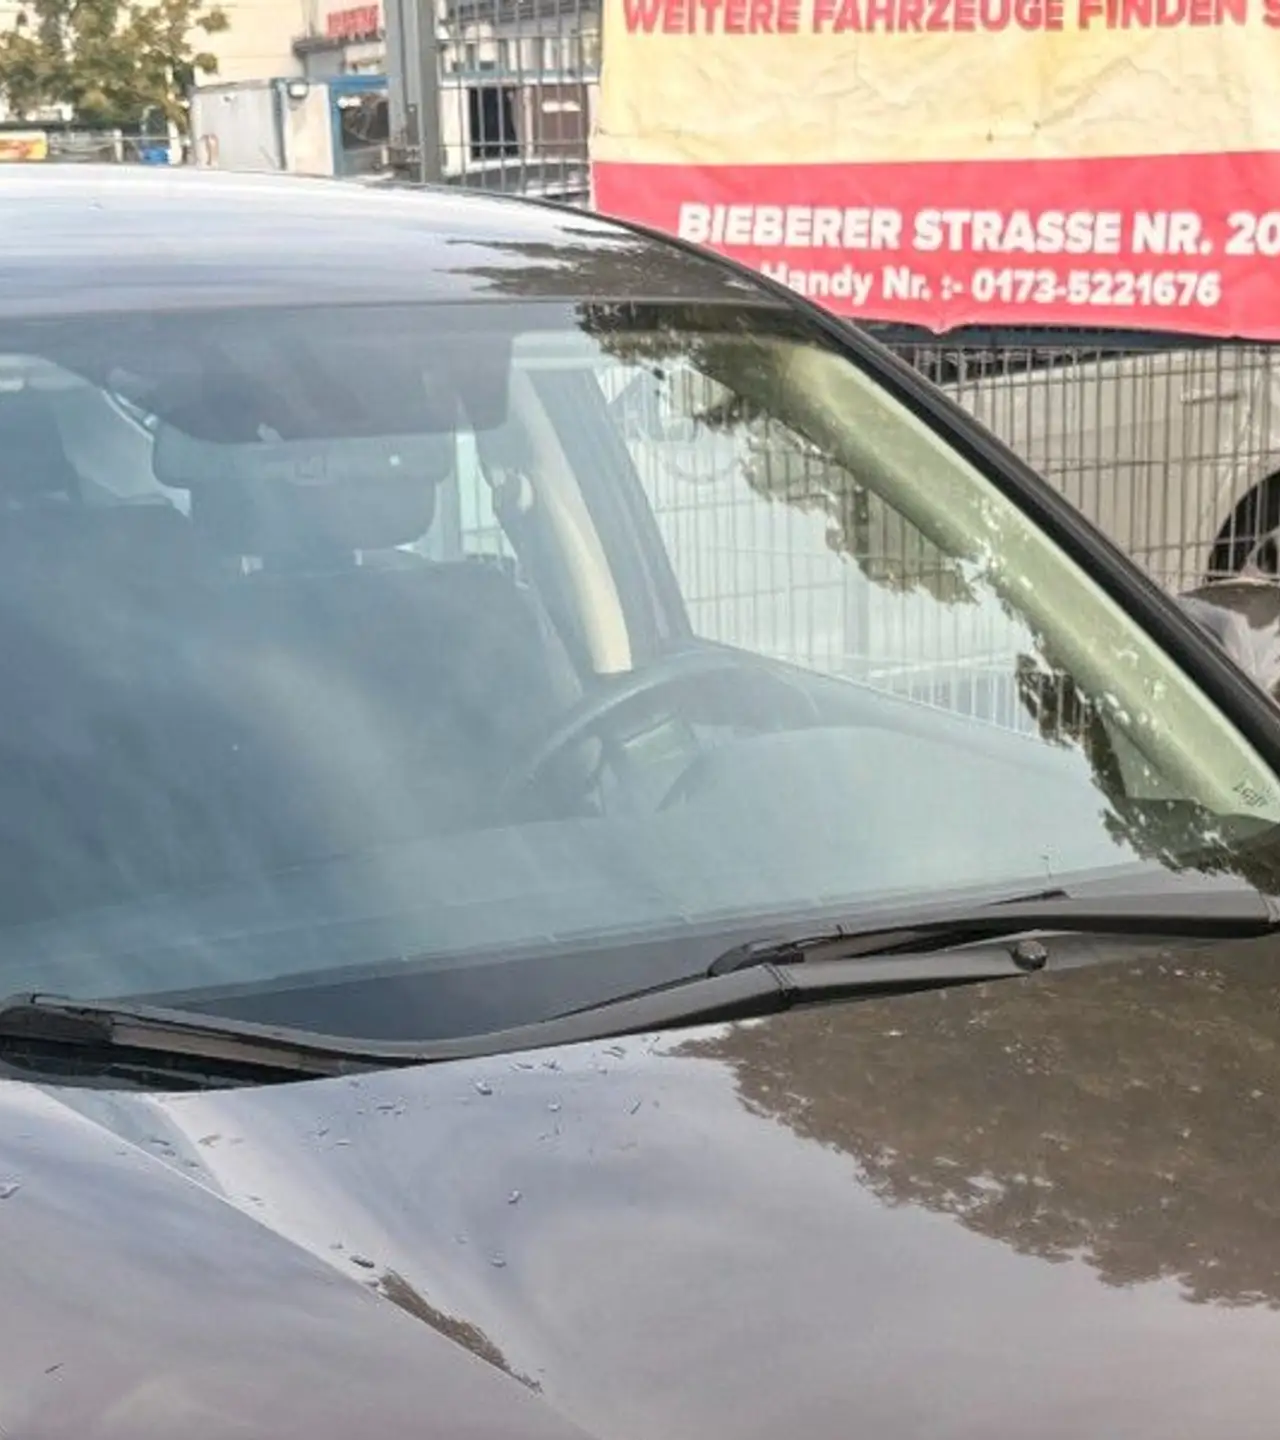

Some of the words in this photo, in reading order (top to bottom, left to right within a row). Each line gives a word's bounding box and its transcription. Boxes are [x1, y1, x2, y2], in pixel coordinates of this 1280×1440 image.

[622, 0, 800, 34] WEITERE
[813, 0, 1063, 34] FAHRZEUGE
[678, 203, 903, 249] BIEBERER
[913, 209, 1122, 254] STRASSE
[1132, 210, 1213, 255] NR.
[882, 264, 932, 301] Nr.
[971, 266, 1222, 307] 0173-5221676
